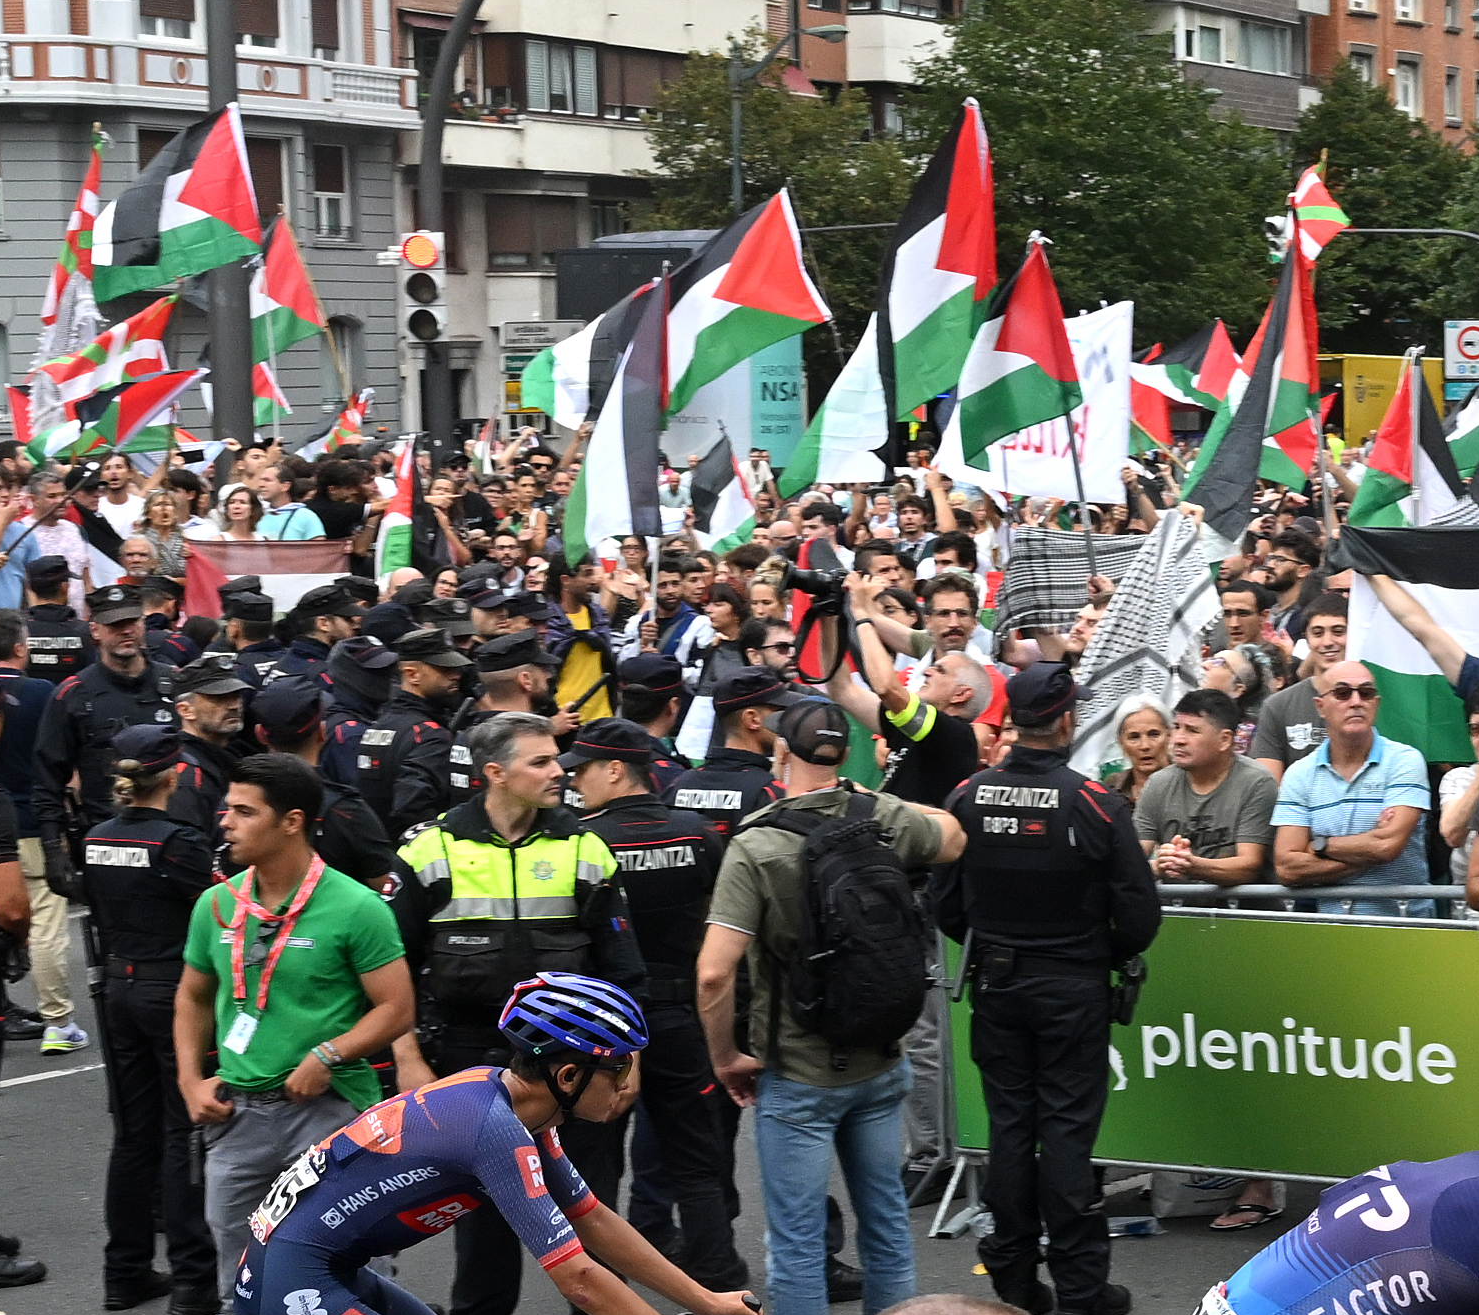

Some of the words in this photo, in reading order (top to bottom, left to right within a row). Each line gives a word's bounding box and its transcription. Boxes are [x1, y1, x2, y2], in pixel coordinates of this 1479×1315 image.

[974, 784, 1059, 808] ERTZAINTZA
[1141, 1012, 1457, 1085] plenitude
[365, 1111, 395, 1147] stnl
[337, 1186, 379, 1217] HANS
[379, 1167, 441, 1196] ANDERS
